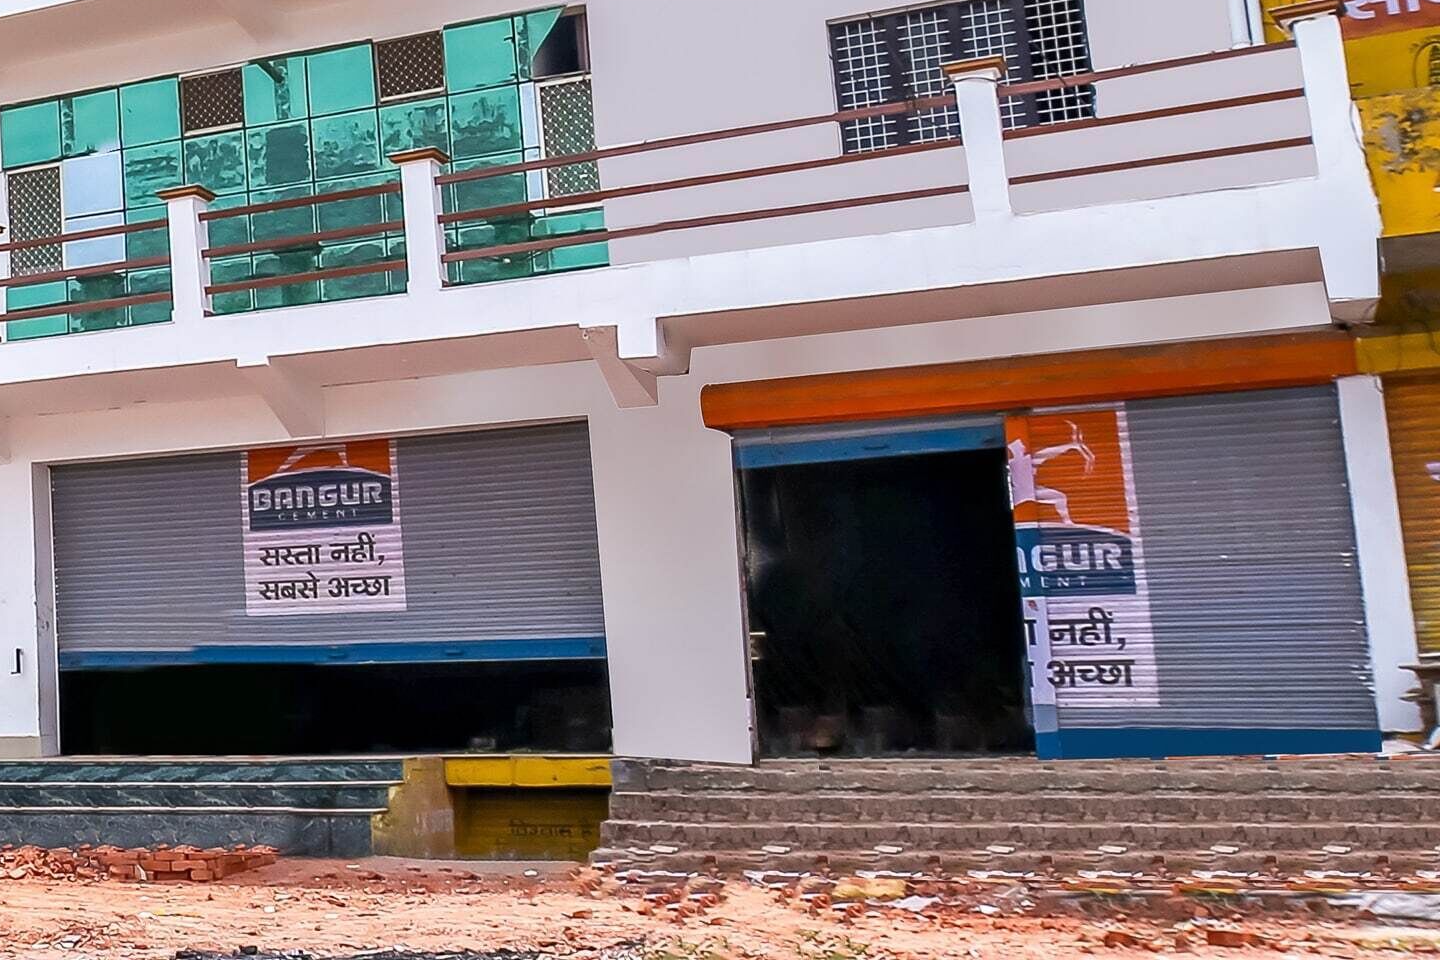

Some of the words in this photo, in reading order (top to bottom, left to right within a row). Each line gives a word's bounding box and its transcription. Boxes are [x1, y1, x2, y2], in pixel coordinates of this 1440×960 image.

[252, 482, 383, 512] BANGUR
[278, 508, 358, 521] CEMENT
[258, 544, 321, 566] सस्ता
[329, 532, 385, 566] नहीं,
[257, 571, 320, 601] सबसे
[328, 575, 392, 598] अच्छा
[1048, 606, 1127, 651] नहीं,
[1047, 658, 1136, 689] अच्छा
